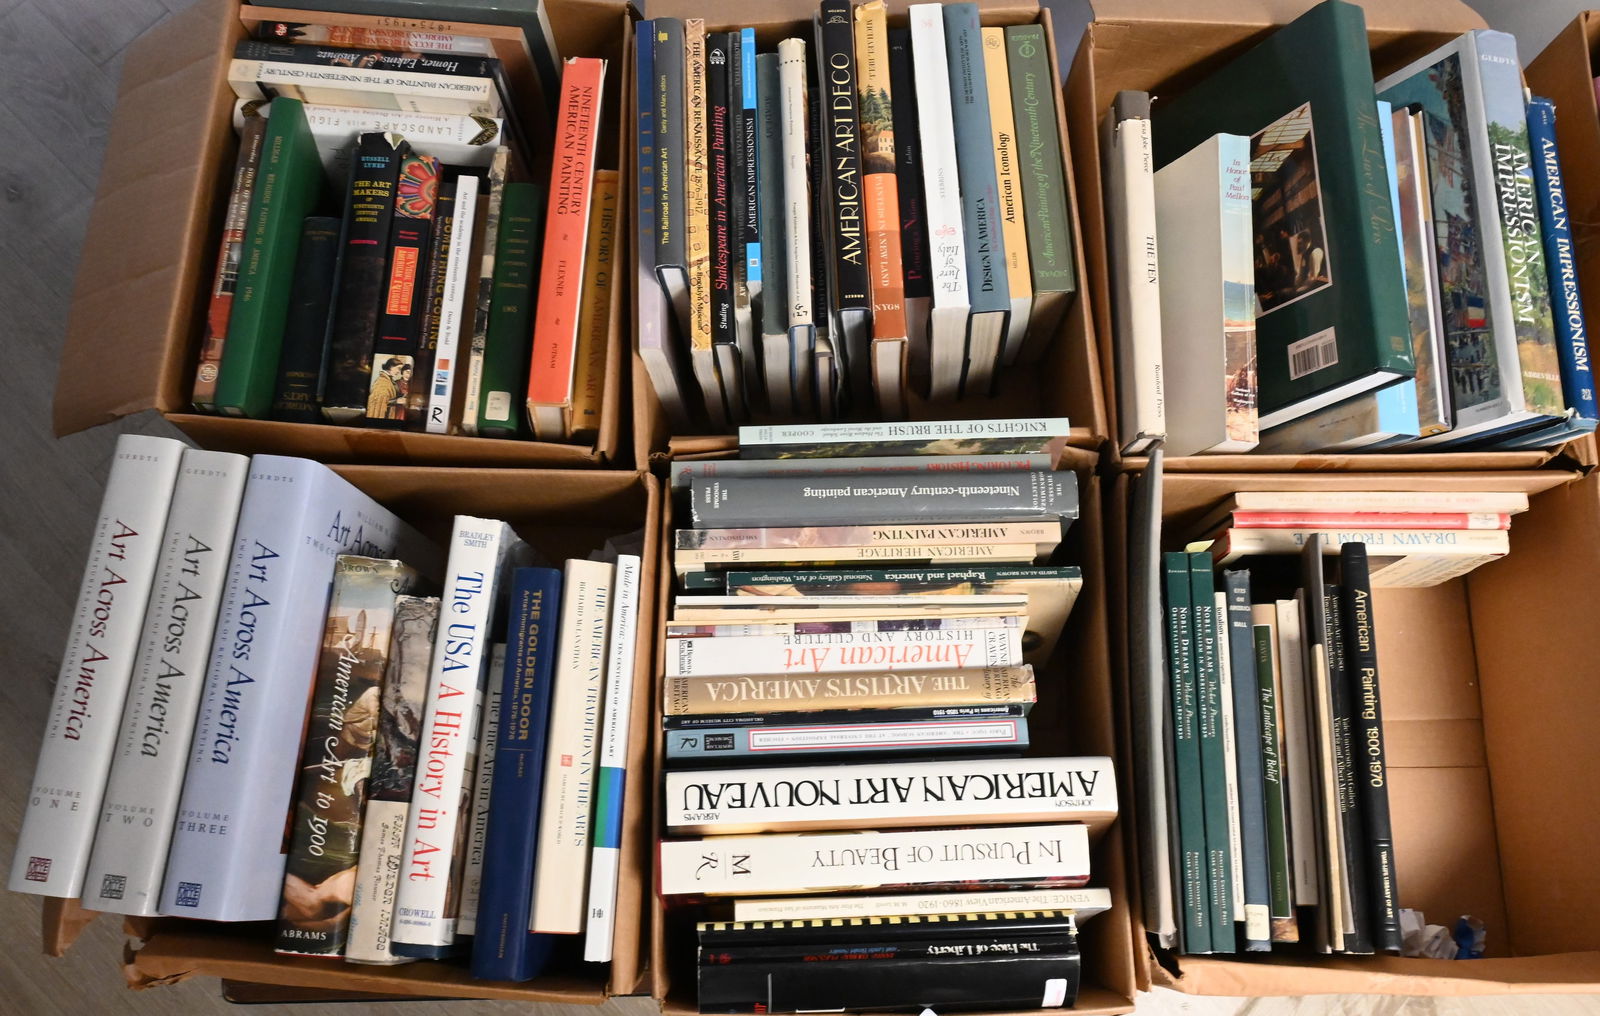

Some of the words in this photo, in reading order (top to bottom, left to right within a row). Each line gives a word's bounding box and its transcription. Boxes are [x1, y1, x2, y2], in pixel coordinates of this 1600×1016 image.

[866, 19, 875, 54] MICHAEL
[316, 50, 360, 65] Anshutz
[692, 41, 700, 58] THE
[1481, 53, 1516, 65] GERDTS
[265, 68, 304, 79] CENTURY
[306, 72, 362, 82] NINETEENTH
[421, 57, 459, 72] Homer,
[867, 56, 876, 80] BELL
[363, 76, 380, 84] THE
[396, 79, 436, 89] PAINTING
[438, 82, 481, 92] AMERICAN
[693, 59, 701, 108] AMERICAN
[830, 52, 853, 110] DECO
[374, 120, 452, 137] LANDSCAPE
[563, 85, 580, 152] AMERICAN
[576, 86, 593, 156] NINETEENTH
[712, 106, 726, 152] Painting
[694, 110, 703, 173] RENAISSANCE
[834, 115, 856, 153] ART
[660, 148, 668, 159] Art
[745, 118, 756, 183] IMPRESSIONISM
[998, 131, 1012, 176] Iconology
[660, 161, 669, 191] American
[713, 155, 726, 204] American
[1226, 166, 1247, 174] Honor
[557, 155, 573, 216] PAINTING
[570, 161, 586, 217] CENTURY
[1225, 191, 1250, 200] Mellon
[747, 185, 758, 233] AMERICAN
[836, 157, 862, 265] AMERICAN
[1002, 179, 1016, 224] American
[1510, 145, 1542, 268] AMERICAN
[661, 202, 669, 230] Railroad
[714, 210, 727, 221] in
[975, 197, 989, 242] AMERICA
[1145, 235, 1156, 257] THE
[1494, 143, 1535, 325] IMPRESSIONISM
[435, 216, 454, 294] SOMETHING
[715, 226, 730, 290] Shakespeare
[879, 238, 888, 259] NEW
[937, 243, 959, 255] Italy
[1541, 137, 1567, 230] AMERICAN
[1555, 237, 1589, 372] IMPRESSIONISM
[555, 260, 567, 297] FLEXNER
[880, 261, 890, 287] LAND
[981, 255, 994, 292] DESIGN
[1146, 260, 1158, 284] TEN
[695, 271, 704, 300] Brooklyn
[937, 280, 962, 291] The
[428, 298, 445, 350] COMING
[696, 301, 704, 331] Museum
[719, 302, 729, 329] Studing
[888, 424, 931, 436] BRUSH
[934, 422, 963, 434] THE
[967, 422, 985, 433] OF
[988, 421, 1047, 433] KNIGHTS
[802, 486, 851, 499] painting
[853, 486, 908, 499] American
[910, 484, 1020, 498] Nineteenth-century
[107, 519, 139, 560] Art
[872, 528, 935, 540] PAINTING
[938, 526, 1008, 539] AMERICAN
[1293, 533, 1330, 545] LE
[1337, 532, 1385, 545] FROM
[1392, 532, 1456, 545] DRAWN
[181, 534, 212, 577] Art
[248, 540, 281, 582] Art
[857, 546, 923, 558] HERITAGE
[926, 545, 995, 557] AMERICAN
[623, 564, 633, 588] Made
[751, 573, 792, 584] Washington
[793, 573, 806, 582] Art,
[807, 574, 817, 583] of
[818, 573, 842, 582] Gallery
[844, 573, 873, 581] National
[885, 572, 924, 582] America
[926, 572, 946, 581] and
[947, 570, 986, 581] Raphael
[89, 565, 128, 638] Across
[452, 570, 485, 614] The
[530, 589, 543, 620] THE
[594, 585, 607, 613] THE
[623, 590, 631, 599] in
[163, 581, 202, 654] Across
[232, 587, 271, 661] Across
[618, 601, 629, 640] America:
[1179, 606, 1189, 635] NOBLE
[1202, 606, 1212, 634] NOBLE
[1353, 589, 1371, 652] American
[441, 622, 475, 673] USA
[588, 616, 605, 682] AMERICAN
[783, 633, 854, 646] CULTURE
[861, 632, 894, 644] AND
[901, 630, 973, 643] HISTORY
[524, 623, 539, 689] GOLDEN
[783, 647, 823, 672] Art
[839, 643, 974, 667] American
[1181, 639, 1191, 674] DREAMS
[1204, 637, 1214, 673] DREAMS
[63, 643, 109, 742] America
[328, 633, 360, 731] American
[438, 681, 464, 700] A
[705, 675, 822, 701] AMERICA
[931, 675, 969, 690] THE
[1262, 687, 1272, 702] The
[1361, 667, 1377, 719] Painting
[139, 658, 186, 758] America
[210, 665, 255, 766] America
[519, 694, 532, 741] DOOR
[582, 686, 600, 759] TRADITION
[1263, 705, 1276, 746] Landscape
[320, 737, 343, 783] Art
[419, 710, 463, 797] History
[1265, 747, 1276, 756] of
[1367, 726, 1383, 787] 1900-1970
[581, 762, 595, 776] IN
[1265, 758, 1278, 784] Belief
[579, 780, 593, 808] THE
[683, 779, 840, 810] NOUVEAU
[848, 776, 914, 804] ART
[923, 770, 1099, 802] AMERICAN
[32, 796, 80, 812] ONE
[317, 793, 334, 809] to
[1054, 799, 1094, 808] JOHNSON
[106, 813, 154, 828] TWO
[180, 822, 228, 835] THREE
[418, 807, 445, 829] in
[574, 811, 589, 848] ARTS
[684, 813, 720, 821] ABRAMS
[308, 816, 328, 856] 1900
[409, 837, 440, 882] Art
[811, 846, 900, 871] BEAUTY
[905, 844, 934, 864] OF
[940, 841, 1031, 865] PURSUIT
[1038, 839, 1063, 863] IN
[281, 928, 327, 940] ABRAMS
[927, 945, 973, 956] Liberty
[976, 945, 989, 954] of
[990, 943, 1018, 954] Face
[1020, 942, 1040, 952] The
